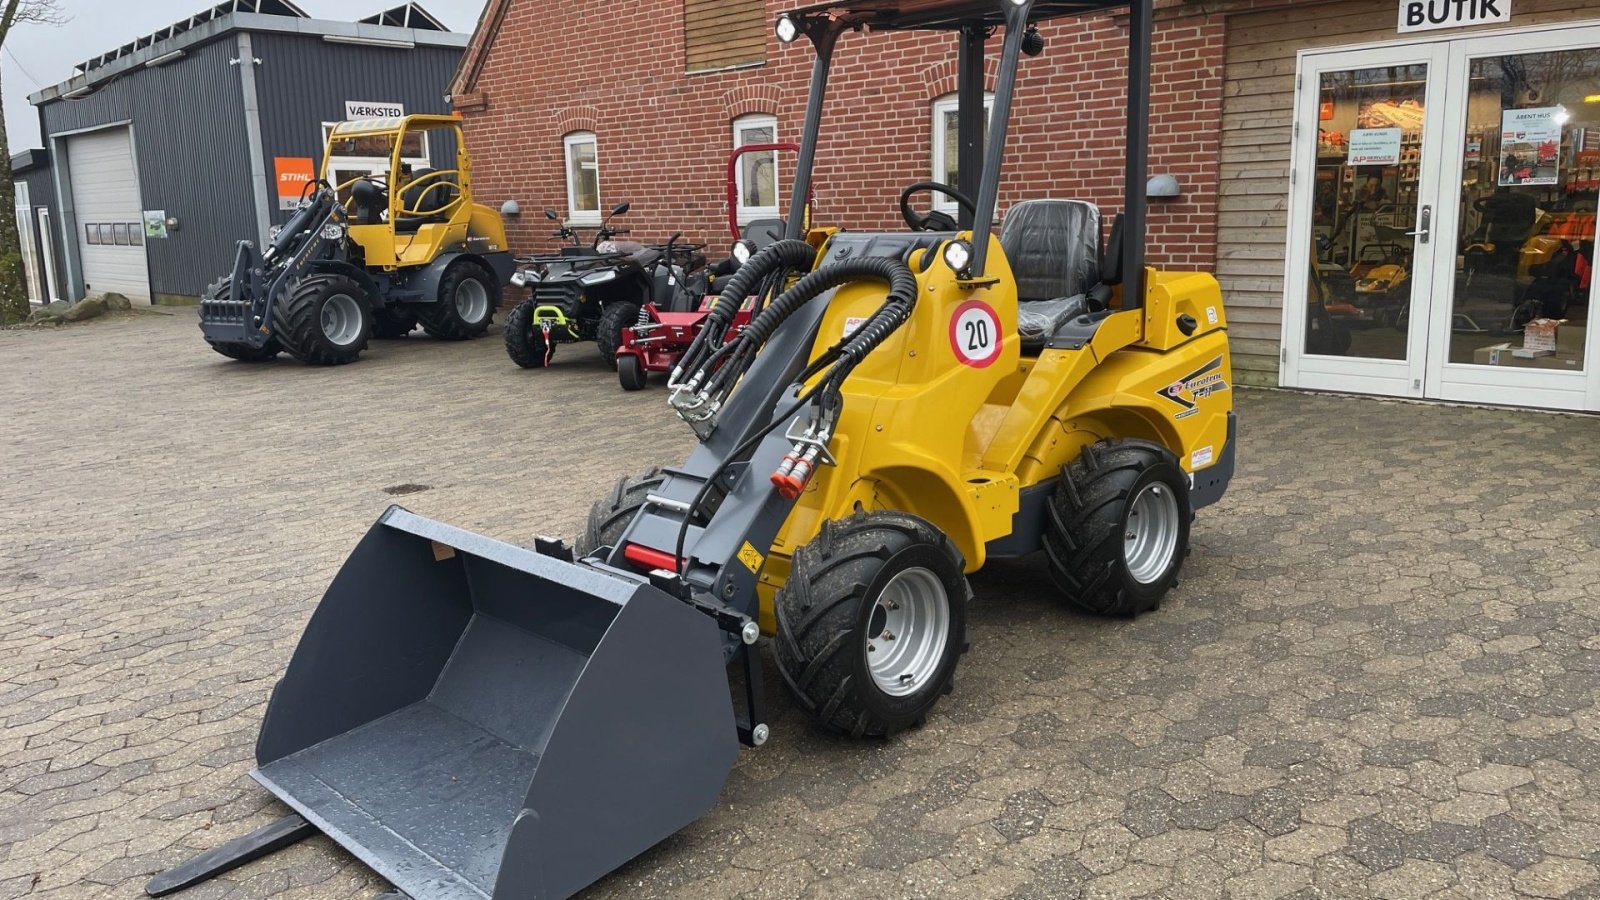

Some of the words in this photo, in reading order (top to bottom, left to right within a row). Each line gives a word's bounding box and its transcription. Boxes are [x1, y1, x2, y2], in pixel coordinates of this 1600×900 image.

[1406, 0, 1501, 26] BUTIK
[349, 106, 401, 117] VÆRKSTED
[280, 172, 312, 181] STIHL
[965, 319, 989, 351] 20
[1185, 373, 1222, 389] Eurotrac
